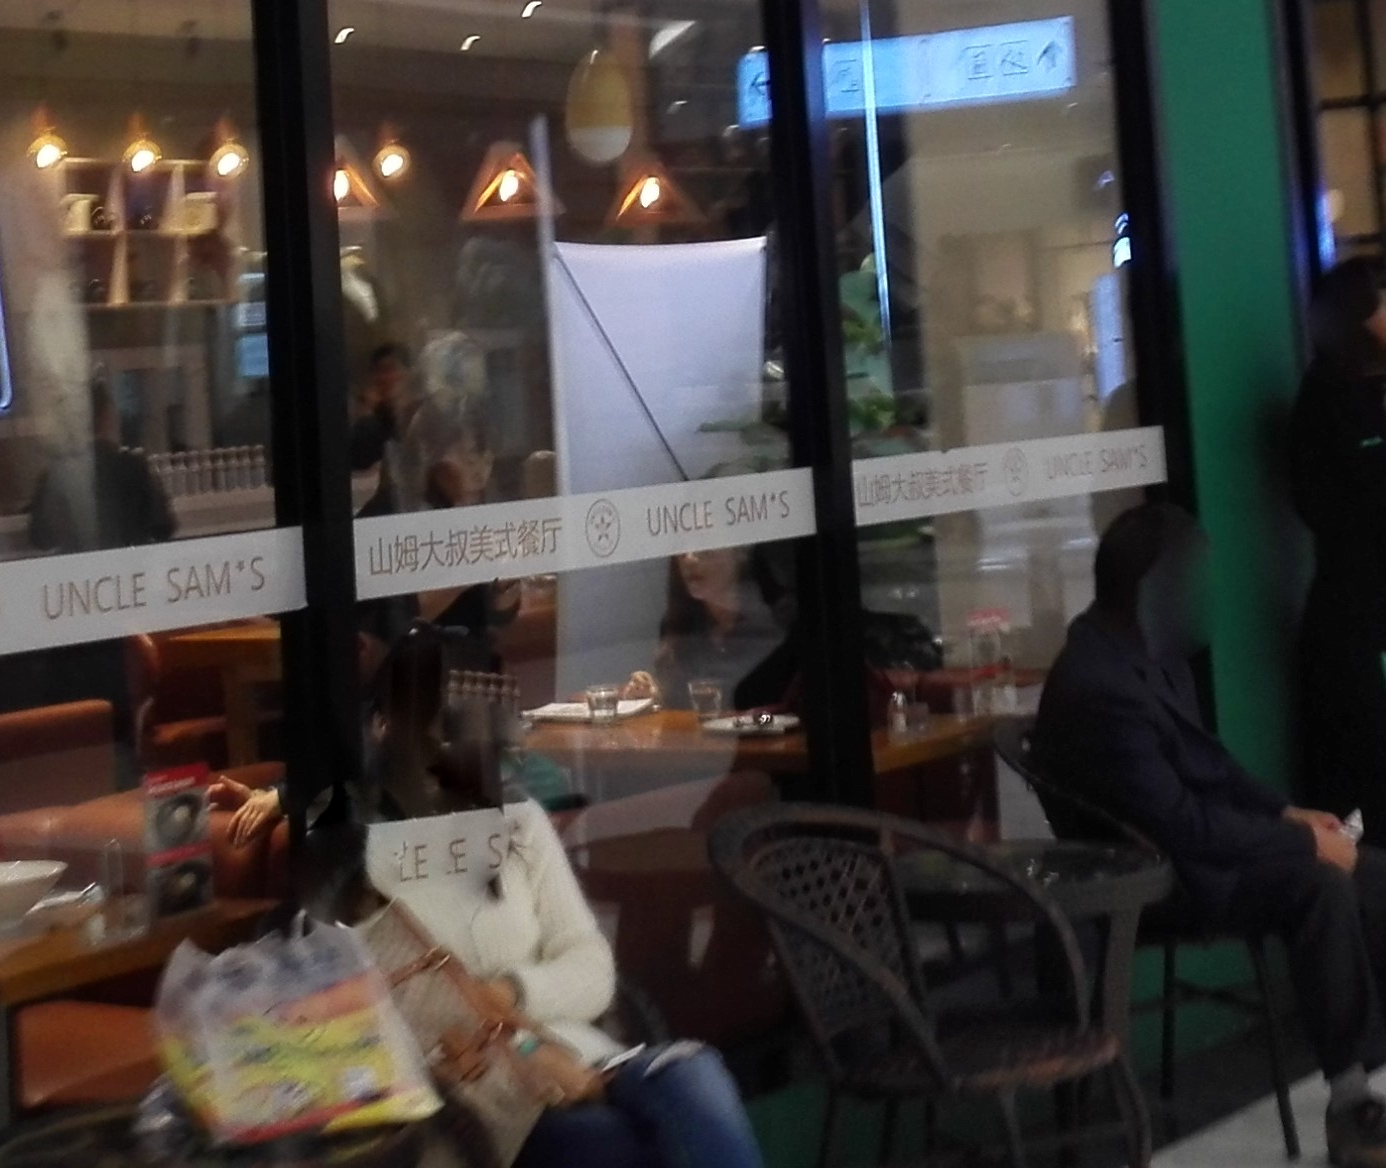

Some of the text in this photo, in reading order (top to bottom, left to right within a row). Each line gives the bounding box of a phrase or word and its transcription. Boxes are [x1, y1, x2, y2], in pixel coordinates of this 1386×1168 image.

[858, 462, 988, 508] 山姆大叔美式餐厅
[647, 500, 714, 537] UNCLE
[369, 515, 563, 576] 山姆大叔美式餐厅
[42, 571, 147, 620] UNCLE
